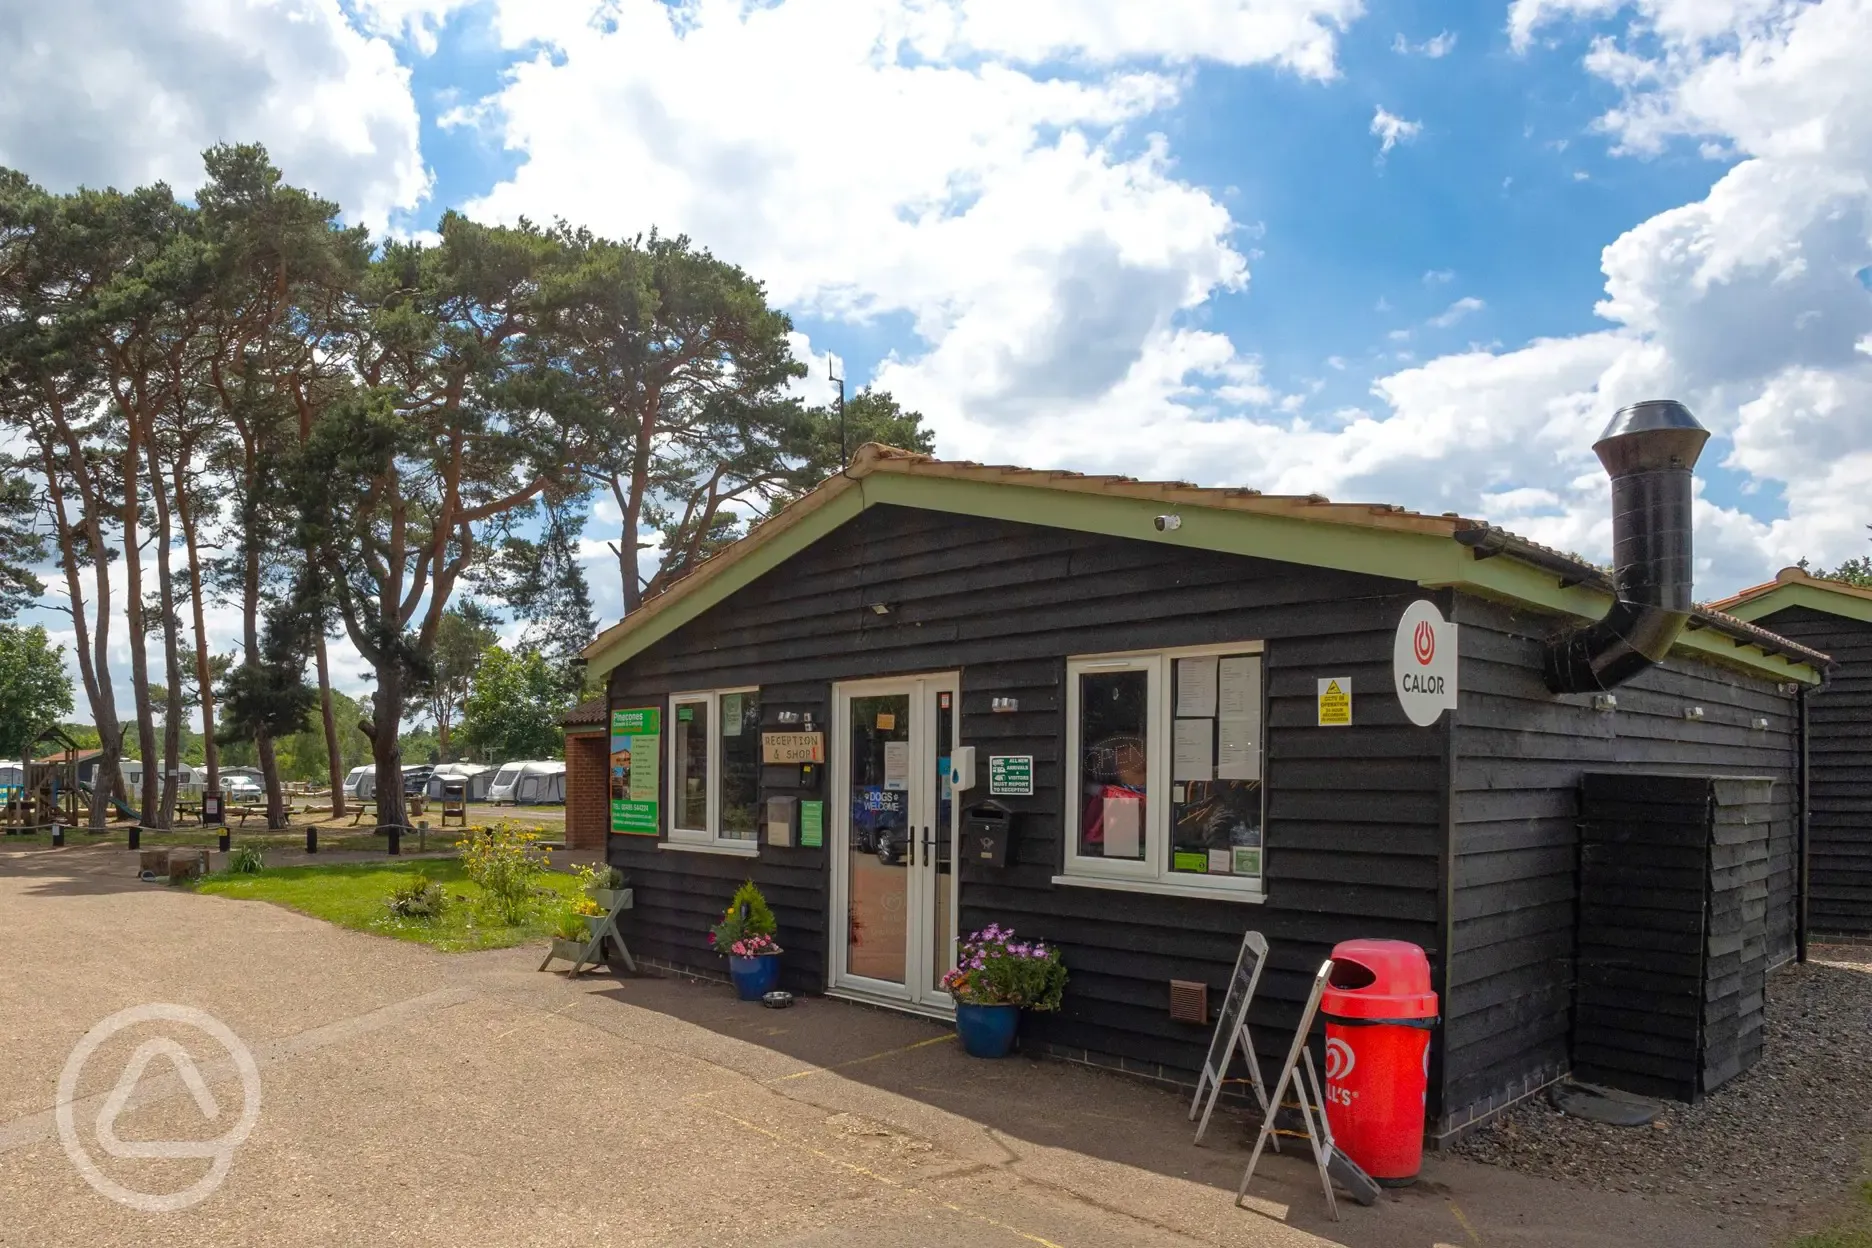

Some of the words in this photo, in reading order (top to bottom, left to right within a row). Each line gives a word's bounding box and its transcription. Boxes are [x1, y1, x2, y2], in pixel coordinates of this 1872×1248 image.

[1402, 673, 1444, 695] CALOR
[614, 712, 644, 722] Pinecones
[765, 735, 818, 747] RECEPTION
[774, 750, 780, 760] &
[1085, 741, 1144, 772] OPEN
[870, 792, 892, 802] DOGS
[864, 801, 899, 811] WELCOME
